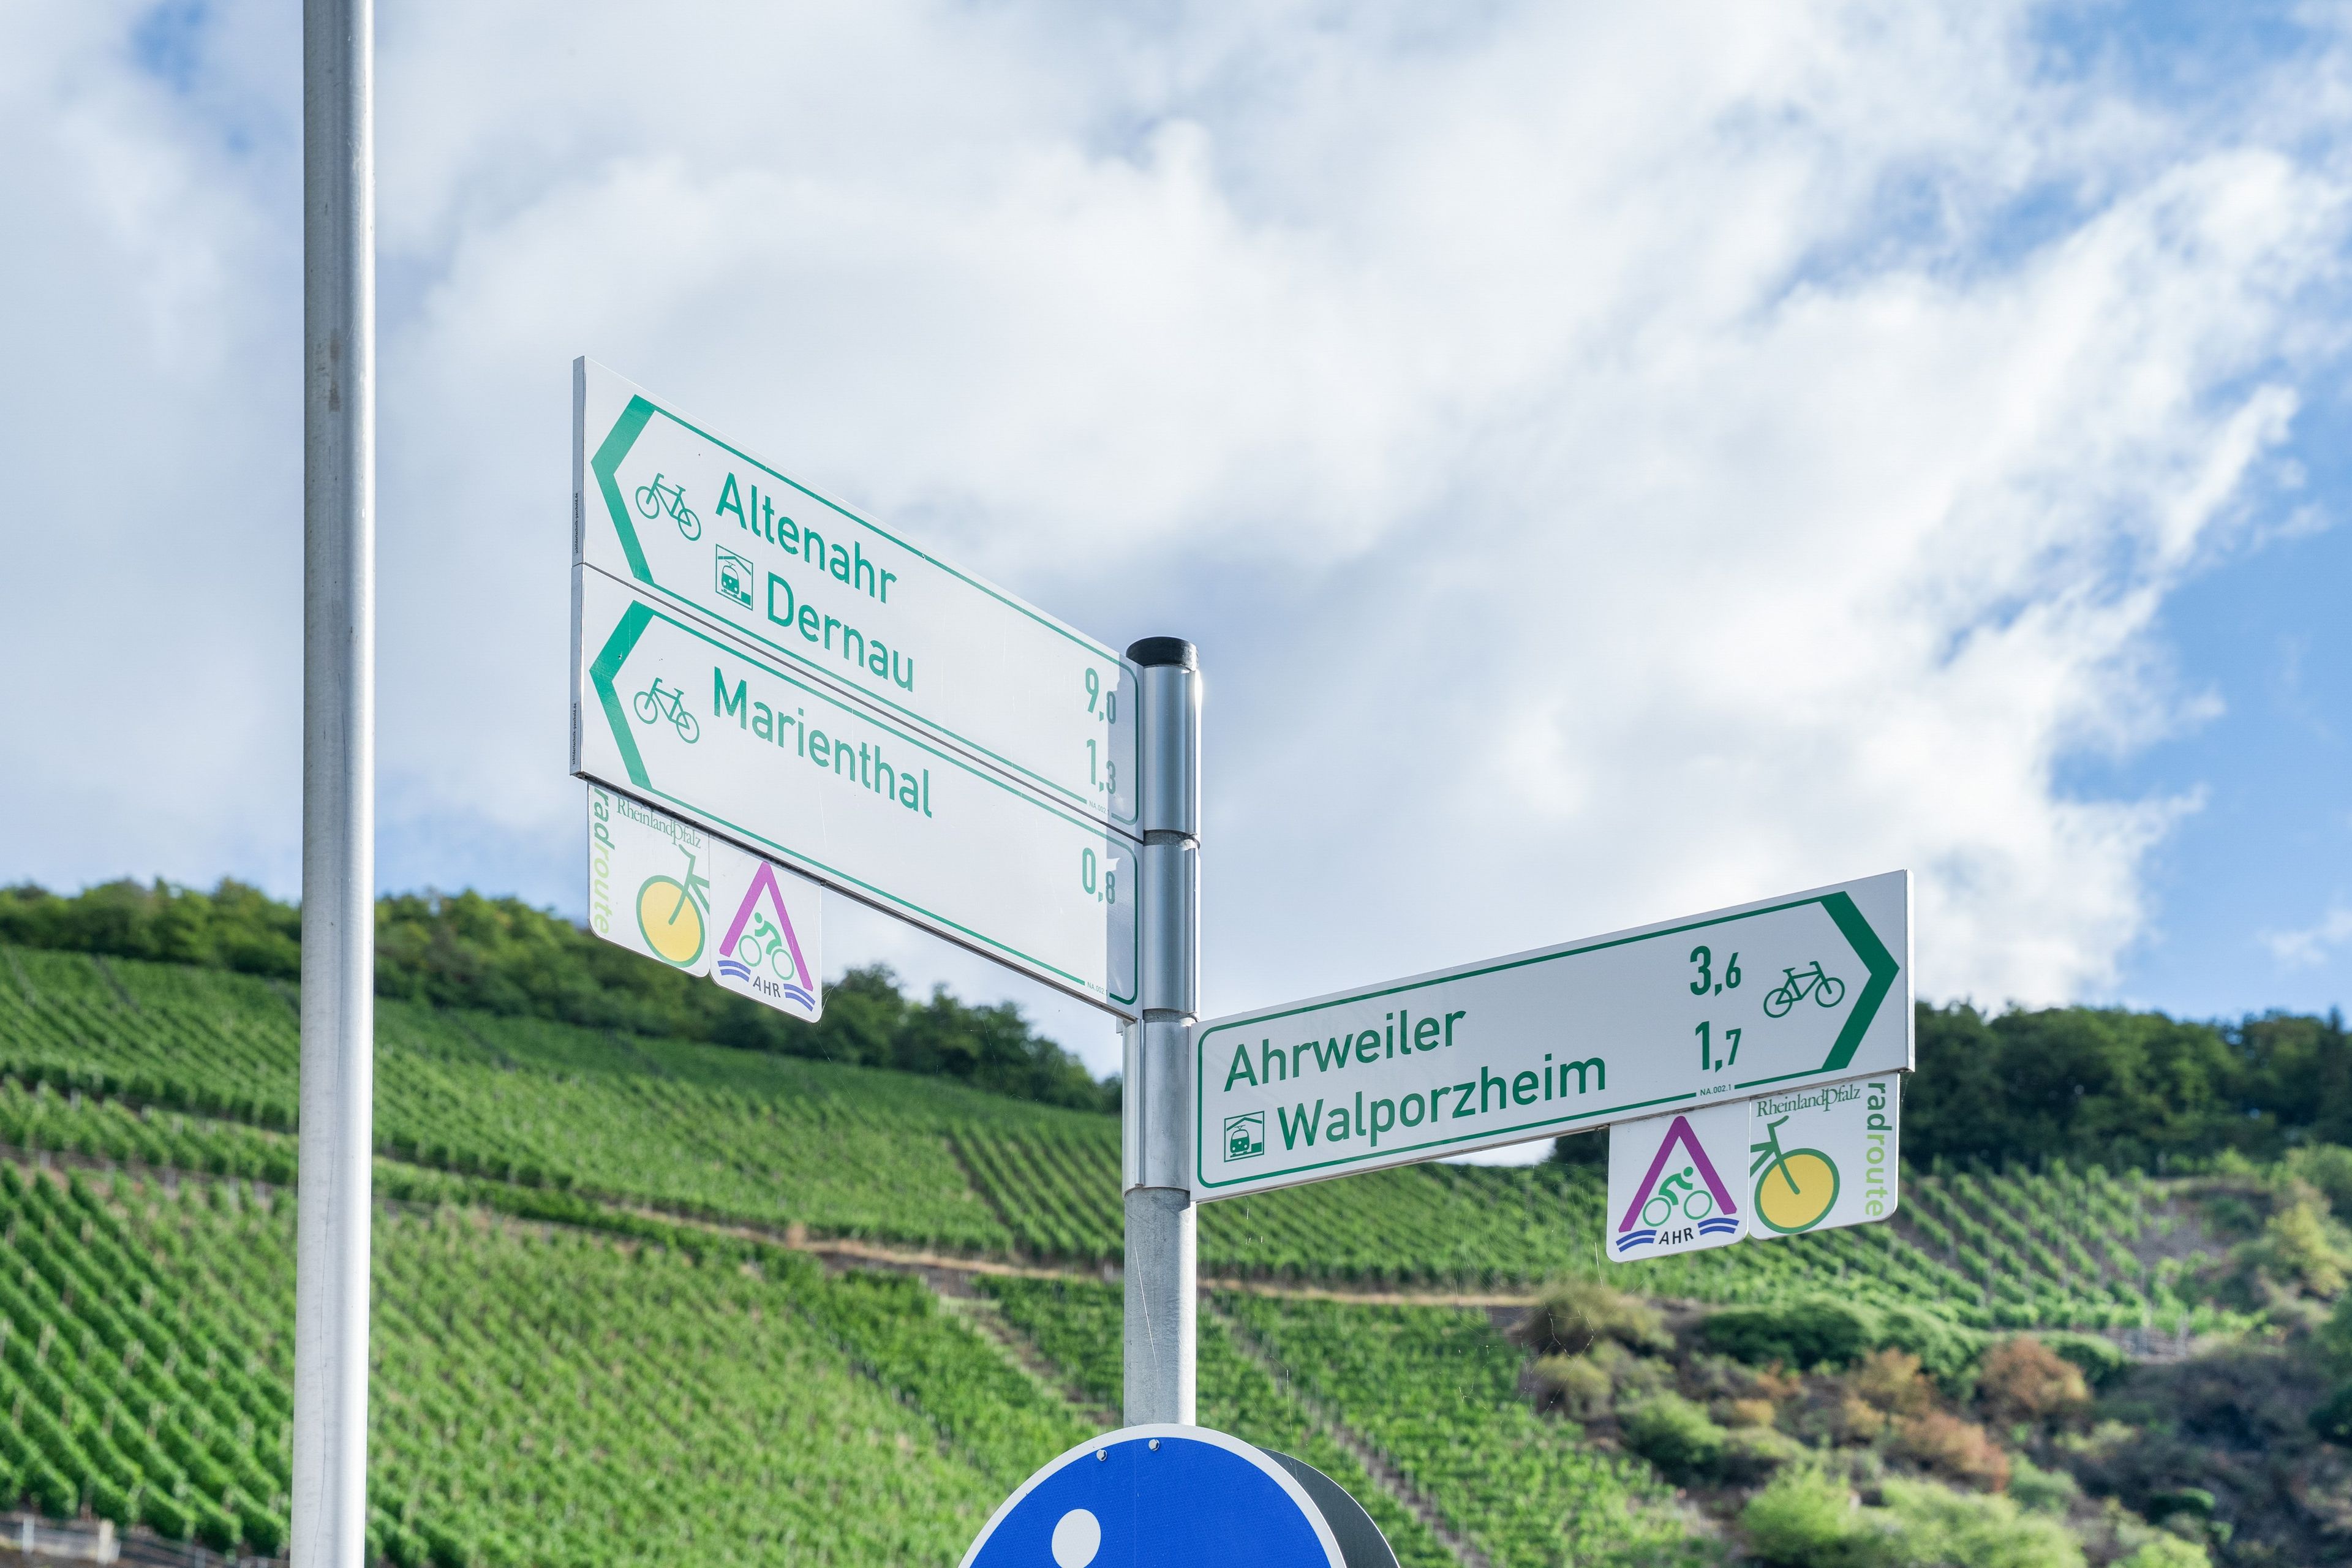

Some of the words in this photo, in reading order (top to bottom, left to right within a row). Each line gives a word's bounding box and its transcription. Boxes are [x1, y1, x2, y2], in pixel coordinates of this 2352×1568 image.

[715, 471, 897, 605] Altenahr
[1085, 667, 1117, 725] 9,0
[767, 571, 913, 693] Dernau
[1086, 738, 1117, 795] 1,3
[714, 665, 932, 819] Marienthal
[1082, 846, 1115, 905] 0,8
[1089, 800, 1109, 816] NA.002.1
[594, 787, 616, 935] radroute
[753, 975, 782, 998] AHR
[1087, 981, 1107, 996] NA.002.1
[1223, 1009, 1467, 1092] Ahrweiler
[1689, 945, 1742, 997] 3,6
[1277, 1053, 1606, 1151] Walporzheim
[1695, 1020, 1742, 1073] 1,7
[1700, 1084, 1731, 1096] NA.002.1
[1864, 1082, 1893, 1216] radroute
[1658, 1226, 1695, 1246] AHR
